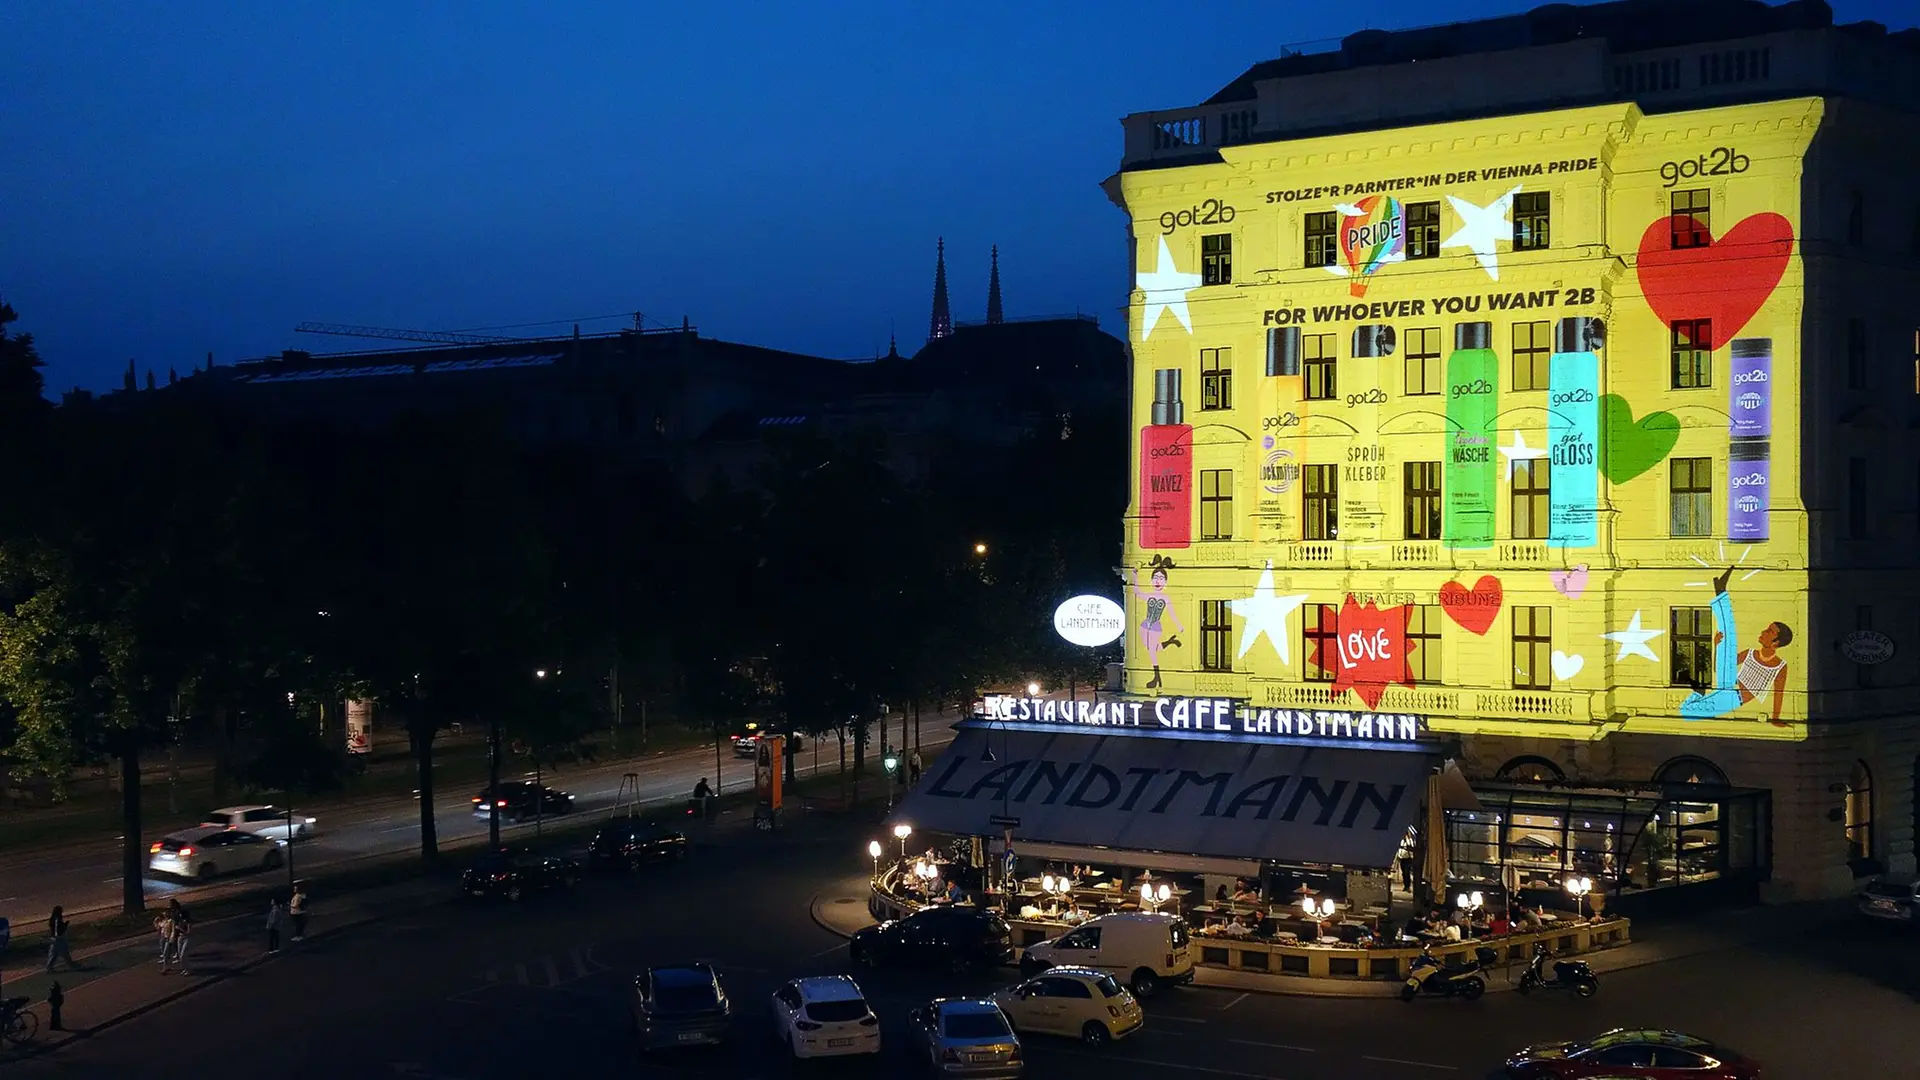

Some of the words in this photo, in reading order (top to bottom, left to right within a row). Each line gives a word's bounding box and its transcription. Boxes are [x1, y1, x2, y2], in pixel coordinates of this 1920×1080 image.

[1444, 171, 1477, 186] DER
[1481, 163, 1543, 181] VIENNA
[1547, 157, 1598, 174] PRIDE
[1660, 147, 1750, 188] got2b
[1160, 199, 1235, 236] got2b
[1349, 215, 1402, 251] PRIDE
[1263, 308, 1307, 326] FOR
[1312, 299, 1425, 323] WHOEVER
[1431, 294, 1481, 315] YOU
[1487, 289, 1562, 312] WANT
[1564, 287, 1596, 306] 2B
[1734, 369, 1768, 385] got2b
[1346, 388, 1388, 409] got2b
[1452, 379, 1493, 400] got2b
[1552, 388, 1594, 407] got2b
[1262, 411, 1300, 431] got2b
[1150, 443, 1185, 460] got2b
[1347, 444, 1386, 462] SPRÜH
[1452, 445, 1490, 463] WÄSCHE
[1552, 443, 1594, 466] GLOSS
[1150, 473, 1184, 493] WAVEZ
[1345, 465, 1387, 482] KLEBER
[1732, 472, 1766, 489] got2b
[1342, 592, 1416, 605] THEATER
[1060, 617, 1120, 629] LANDTMANN
[1337, 628, 1391, 669] LOVE
[991, 695, 1144, 726] RESTAURANT
[1243, 712, 1418, 741] LANDTMANN
[924, 755, 1407, 831] LANDTMANN
